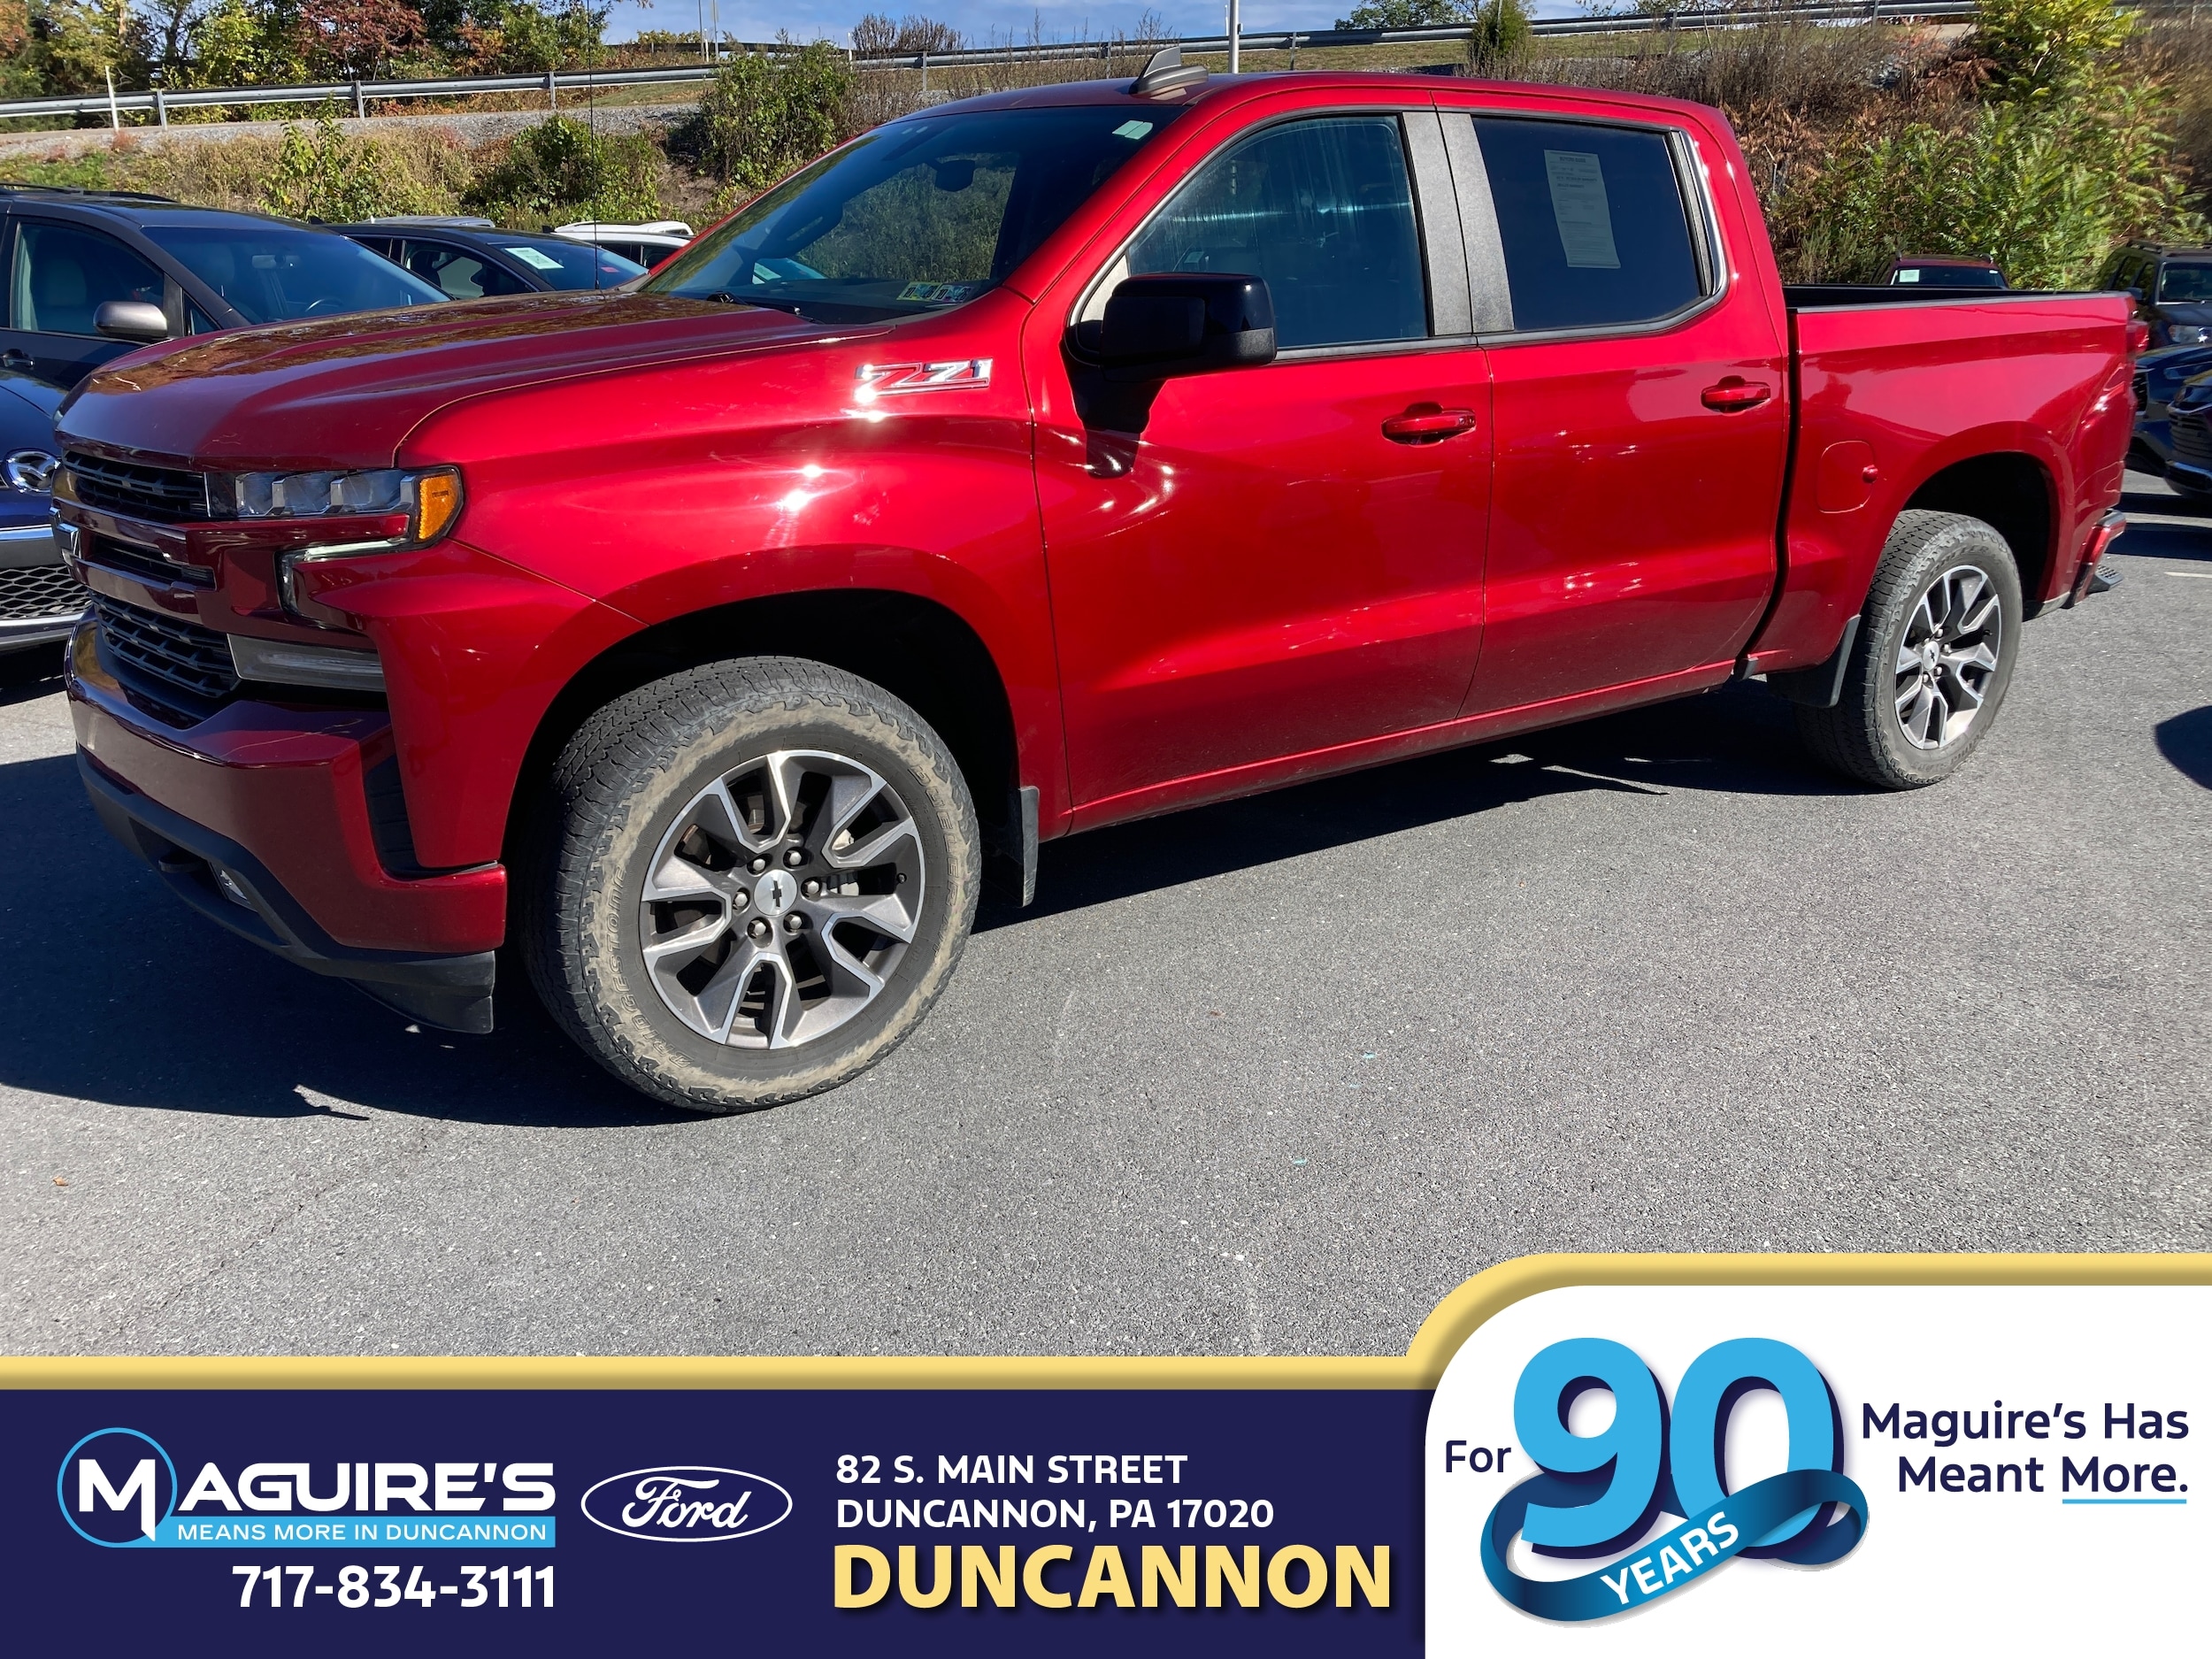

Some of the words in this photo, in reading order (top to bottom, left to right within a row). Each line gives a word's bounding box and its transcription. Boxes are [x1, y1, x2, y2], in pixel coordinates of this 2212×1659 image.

[855, 357, 993, 398] Z71
[908, 764, 959, 907] DUELER
[605, 865, 695, 1070] BRIDGESTONE
